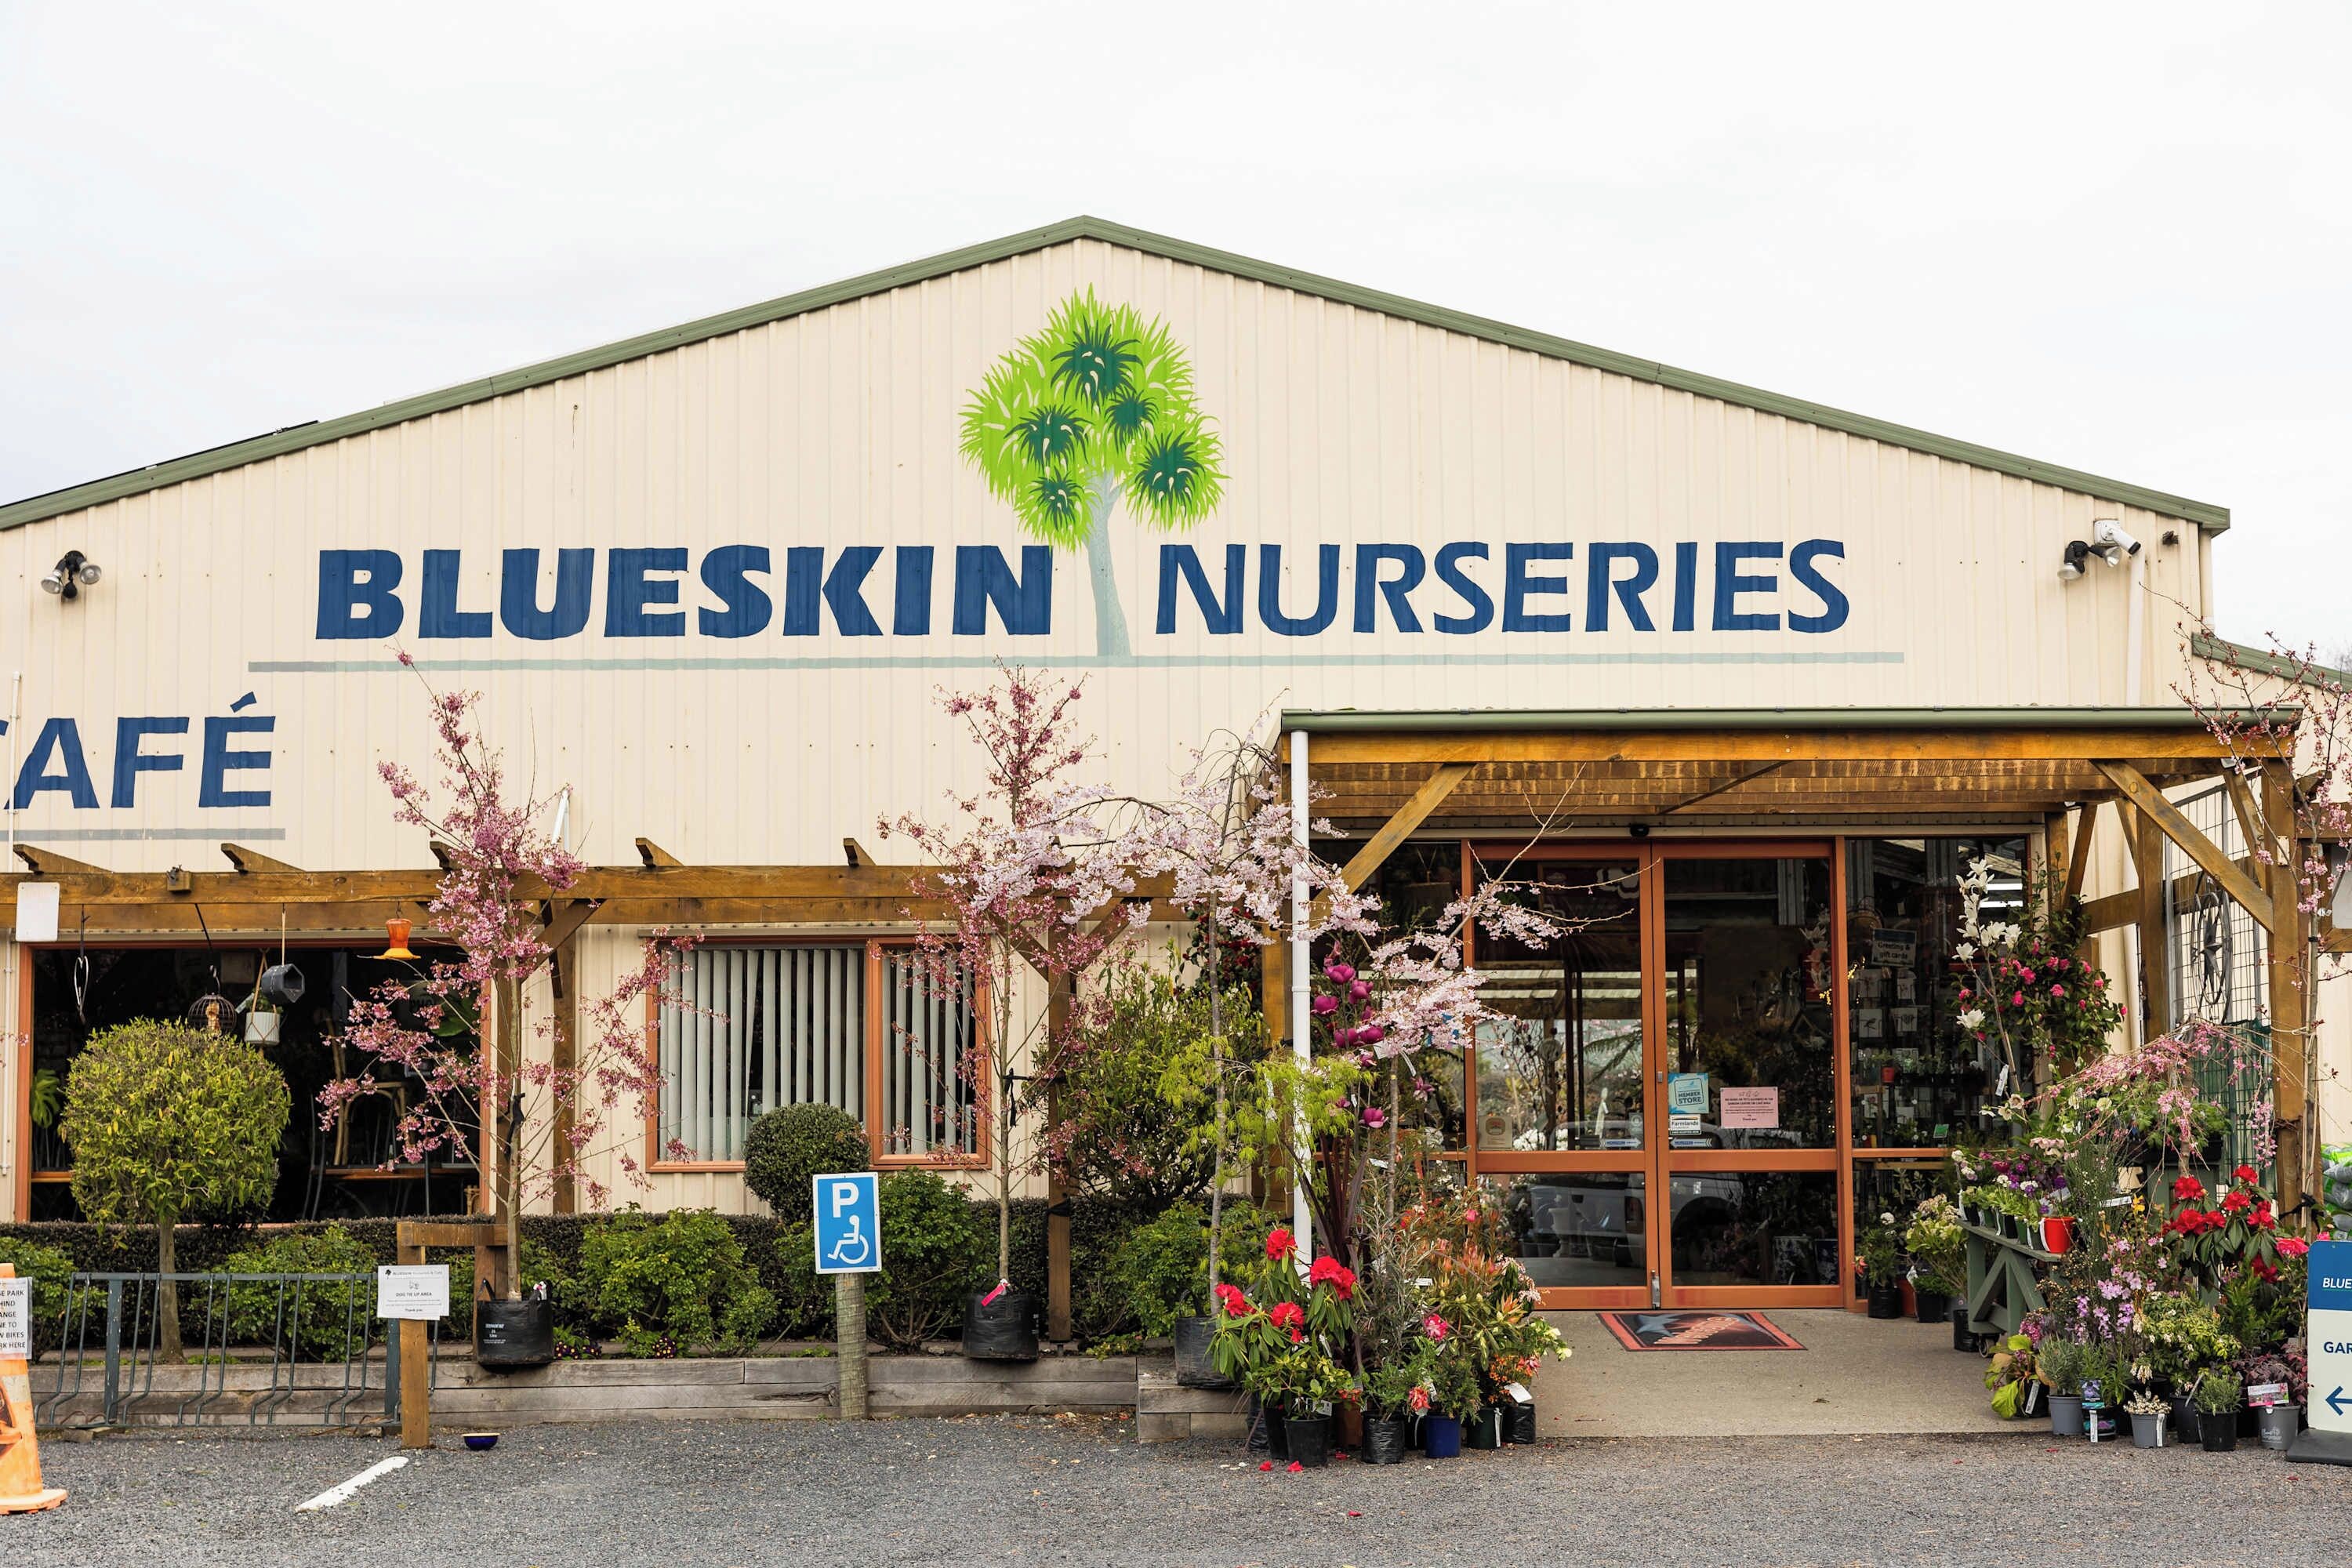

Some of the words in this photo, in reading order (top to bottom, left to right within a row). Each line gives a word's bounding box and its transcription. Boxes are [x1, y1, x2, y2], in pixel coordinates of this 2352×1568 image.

[316, 545, 1053, 641] BLUESKIN
[1156, 539, 1849, 636] NURSERIES
[0, 691, 276, 809] AFÉ
[832, 1182, 859, 1218] P
[2322, 1277, 2352, 1288] BLUE
